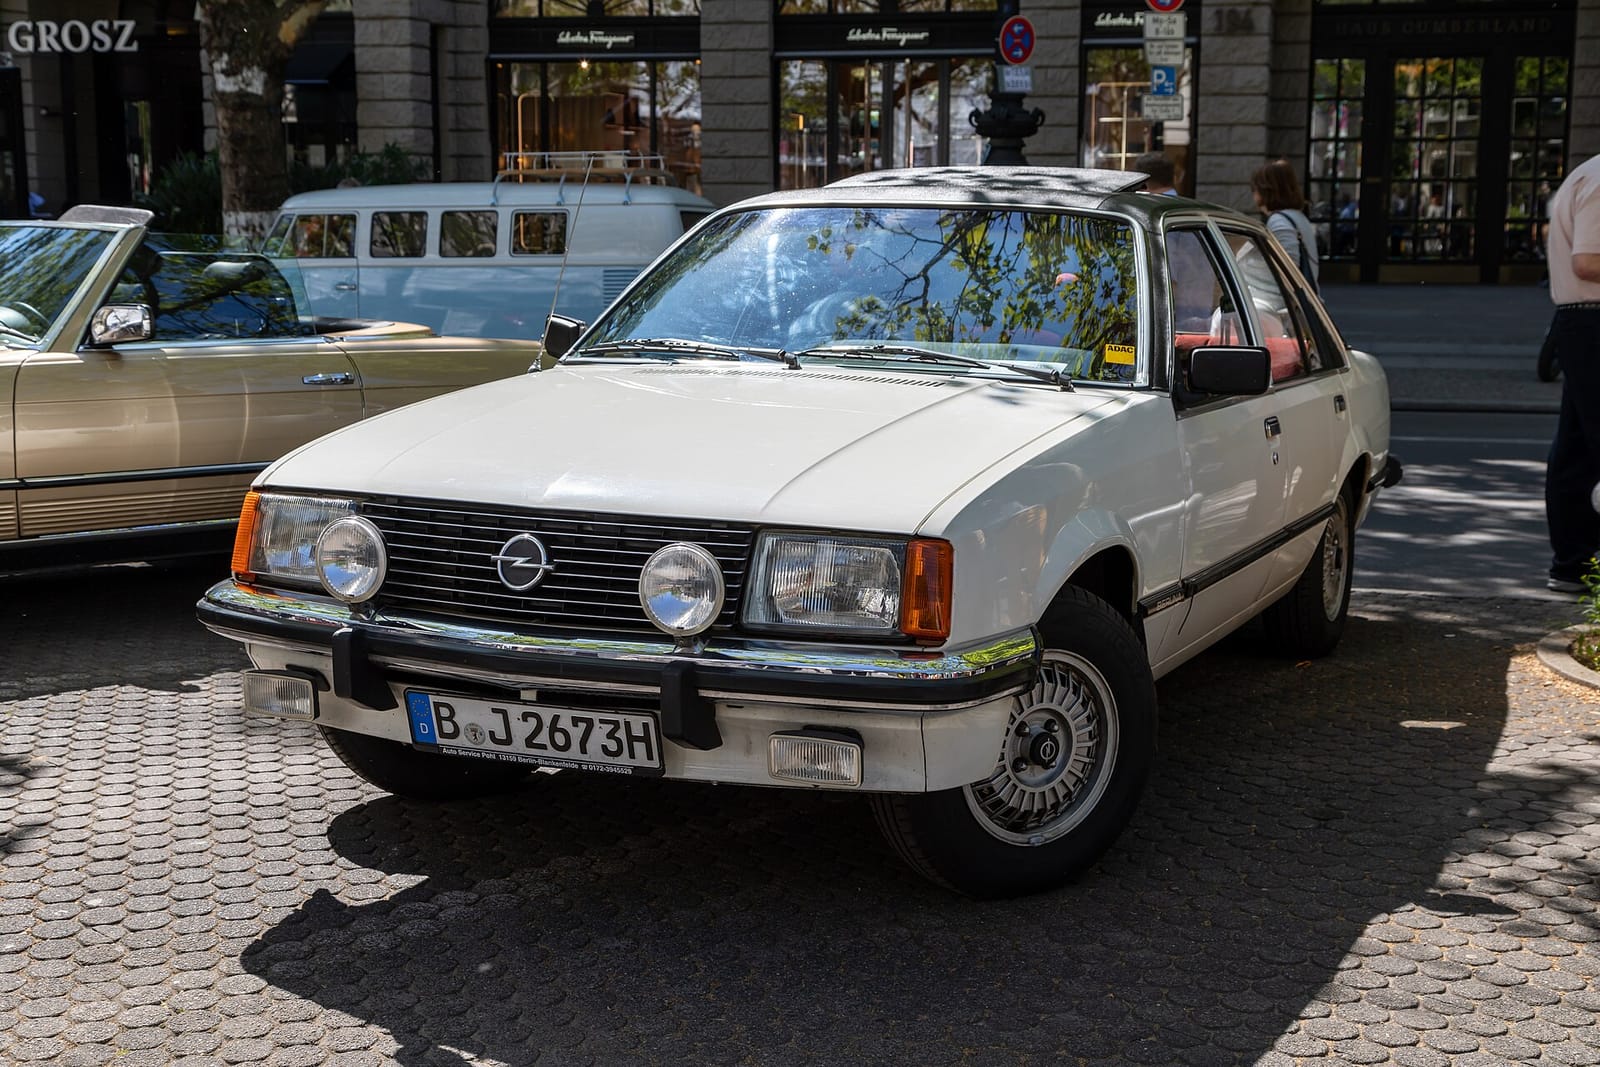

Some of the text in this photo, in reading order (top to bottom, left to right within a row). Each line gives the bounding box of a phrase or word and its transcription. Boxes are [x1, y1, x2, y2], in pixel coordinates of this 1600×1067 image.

[8, 20, 139, 52] GROSZ
[1401, 17, 1552, 35] CUMBERLAND
[846, 27, 929, 46] Salvatore Ferragamo
[1153, 69, 1167, 92] P
[1107, 345, 1133, 353] ADAC
[419, 722, 429, 734] D
[433, 701, 461, 740] B
[442, 747, 457, 755] Auto
[458, 749, 481, 758] Service
[482, 752, 496, 760] Pohl
[499, 754, 517, 762] 13159
[518, 756, 579, 769] Berlin-Blankenfelde
